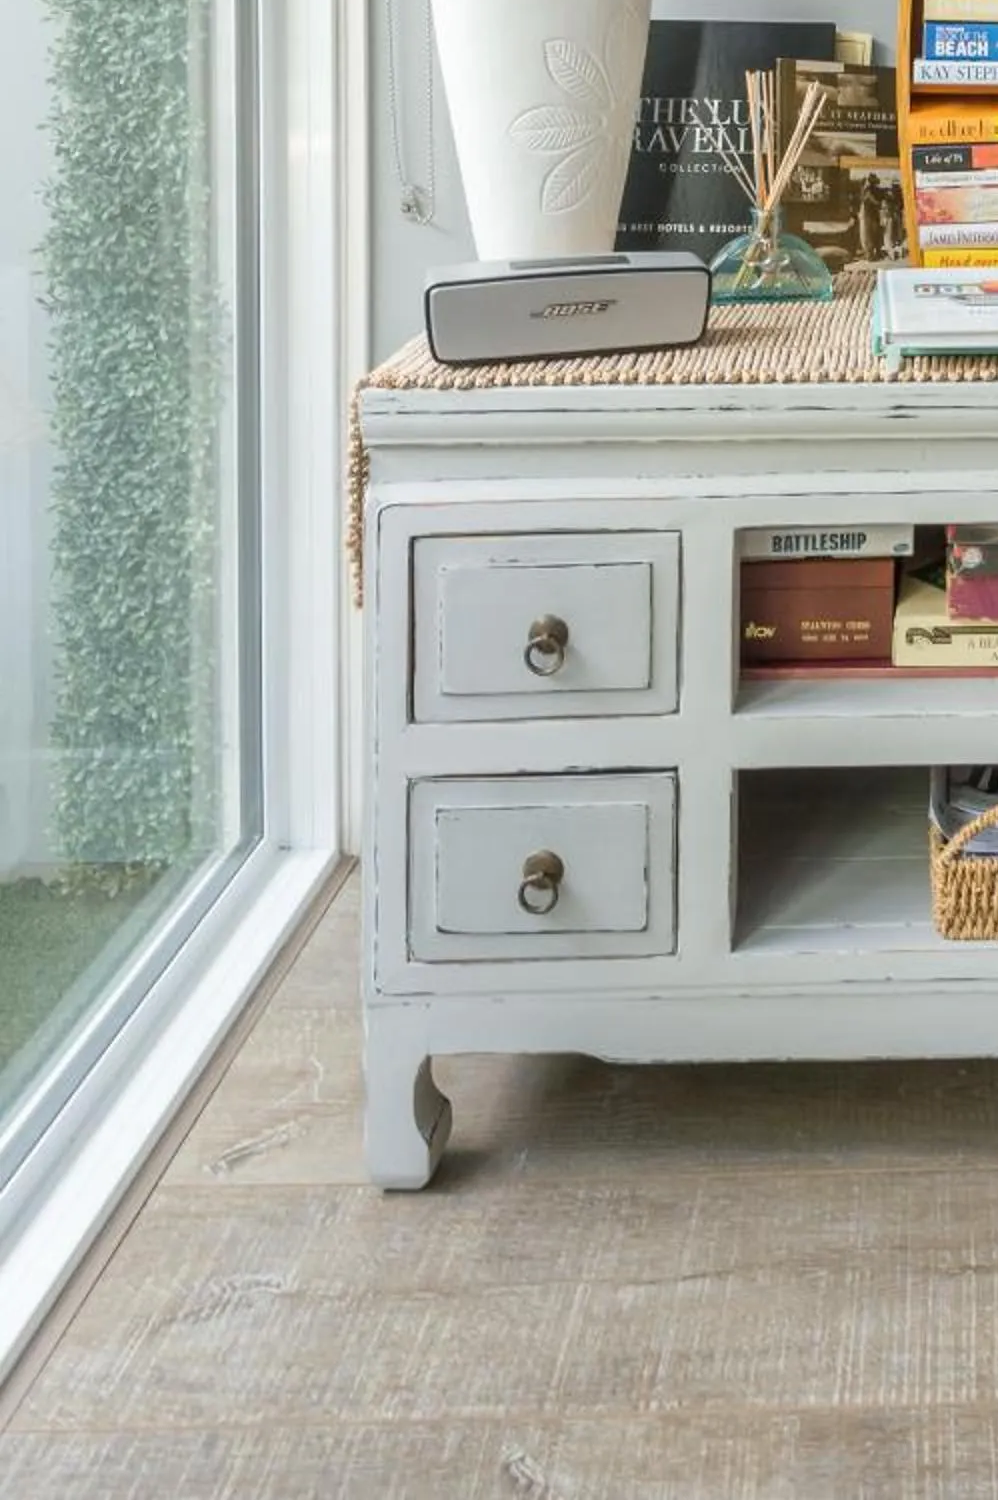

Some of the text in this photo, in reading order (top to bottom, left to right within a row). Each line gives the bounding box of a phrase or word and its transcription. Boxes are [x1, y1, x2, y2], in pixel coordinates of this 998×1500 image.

[935, 40, 988, 57] BEACH
[920, 65, 950, 81] KAY
[659, 162, 742, 174] COLLECTION
[657, 223, 695, 233] HOTELS
[939, 253, 972, 267] Head
[974, 257, 998, 267] over
[534, 300, 614, 319] BOSE
[771, 531, 867, 553] BATTLESHIP
